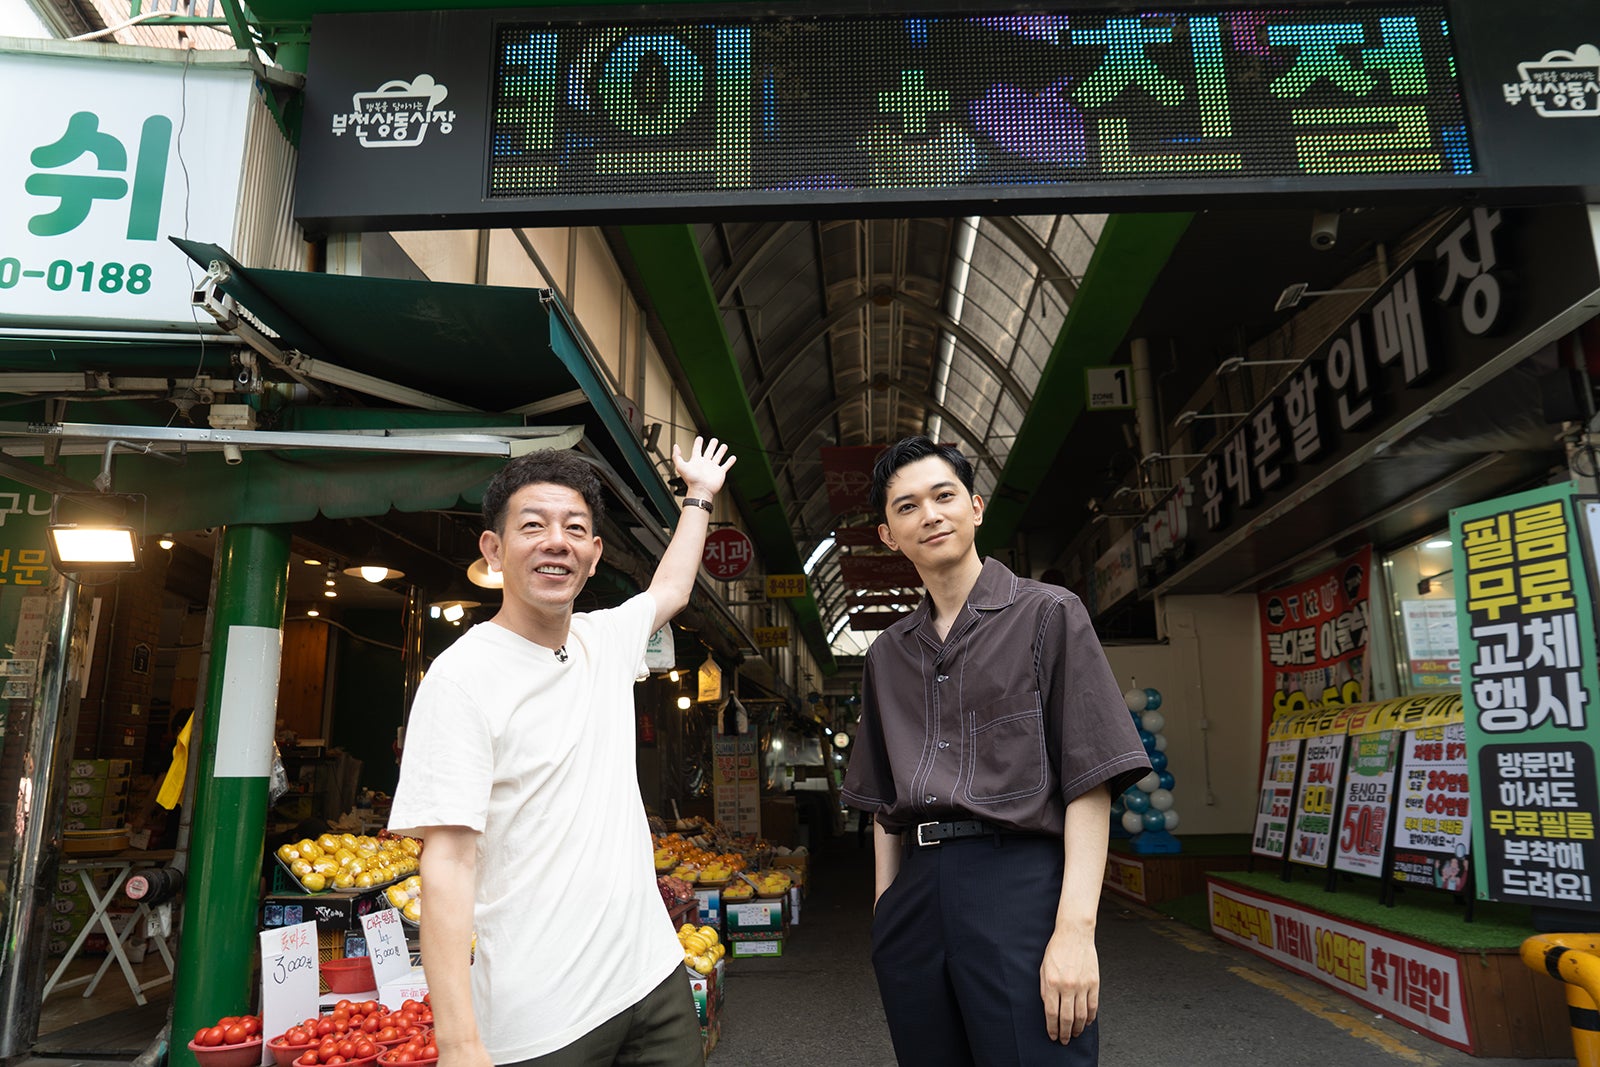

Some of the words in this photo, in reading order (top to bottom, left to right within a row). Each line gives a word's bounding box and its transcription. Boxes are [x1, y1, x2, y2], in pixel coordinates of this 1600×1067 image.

[1070, 16, 1443, 176] 친절
[331, 110, 457, 141] 부천상동시장
[705, 540, 750, 563] 치과
[1464, 501, 1567, 571] 필름
[718, 564, 739, 575] 2F
[1468, 558, 1575, 621] 무료
[1267, 626, 1316, 666] 휴대폰
[1472, 612, 1582, 677] 교체
[1474, 672, 1589, 733] 행사
[1498, 752, 1576, 780] 방문만
[1349, 783, 1388, 803] 통신요금
[1499, 781, 1579, 809] 하셔도
[1488, 809, 1596, 840] 무료필름
[1502, 839, 1586, 871] 부착해
[1502, 871, 1593, 903] 드려요!
[281, 928, 310, 951] 토마토
[1274, 913, 1313, 964] 지참시
[1314, 926, 1368, 992] 10만원
[1371, 946, 1451, 1025] 추가할인
